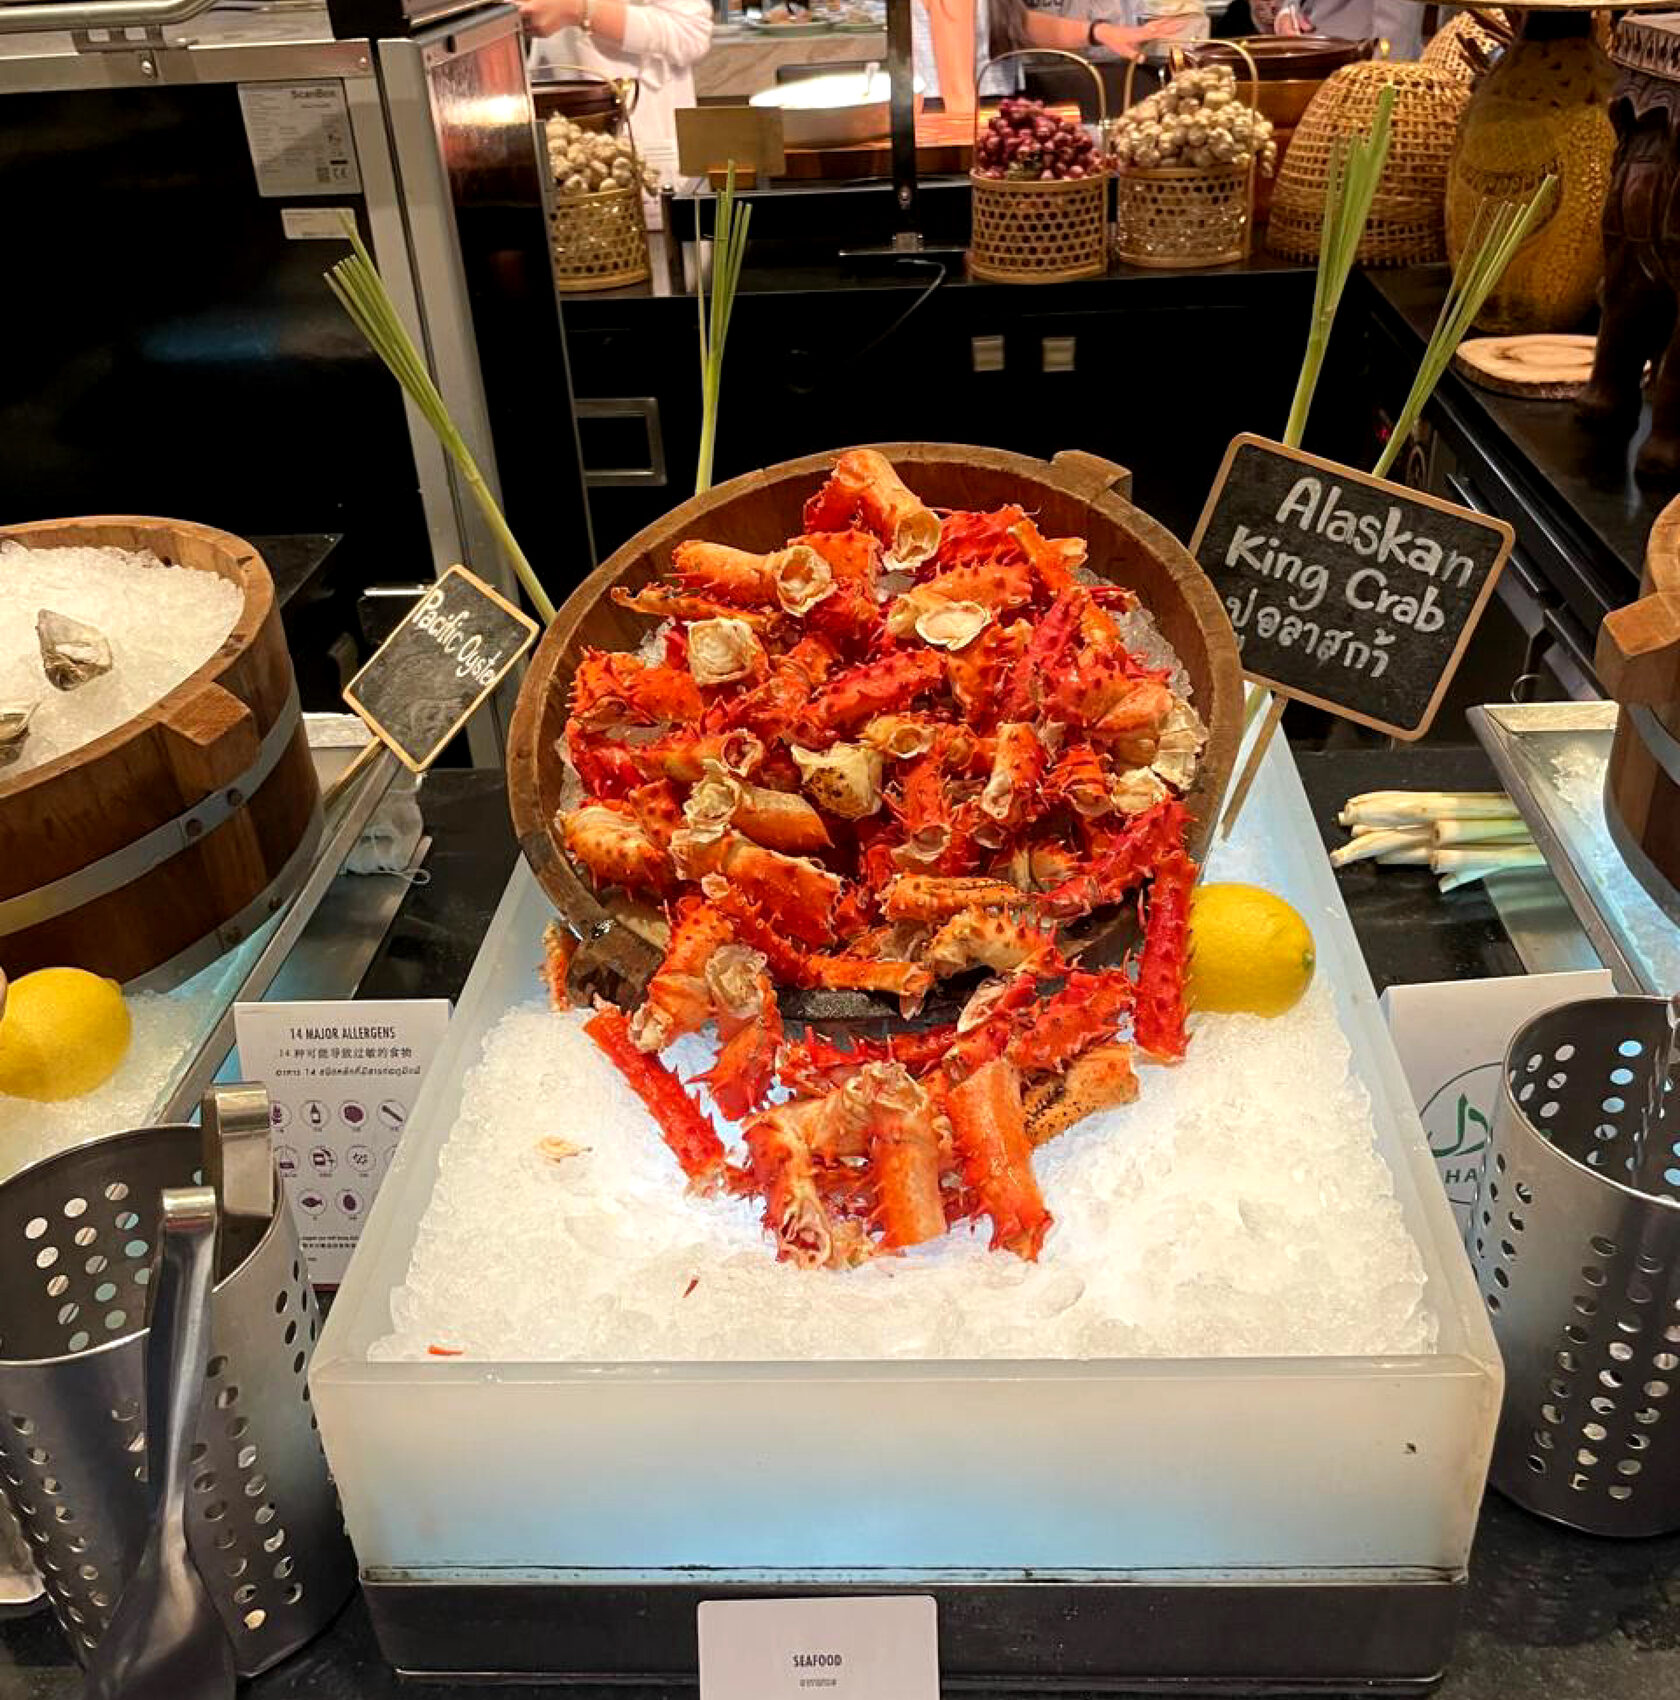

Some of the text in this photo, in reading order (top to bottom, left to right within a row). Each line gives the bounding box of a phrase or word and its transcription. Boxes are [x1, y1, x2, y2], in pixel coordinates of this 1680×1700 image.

[1275, 476, 1474, 588] Alaskan
[1224, 525, 1446, 633] King Crab
[412, 589, 470, 654] Pacific
[290, 1026, 396, 1040] 14 MAJOR ALLERGENS
[792, 1654, 842, 1667] SEAFOOD
